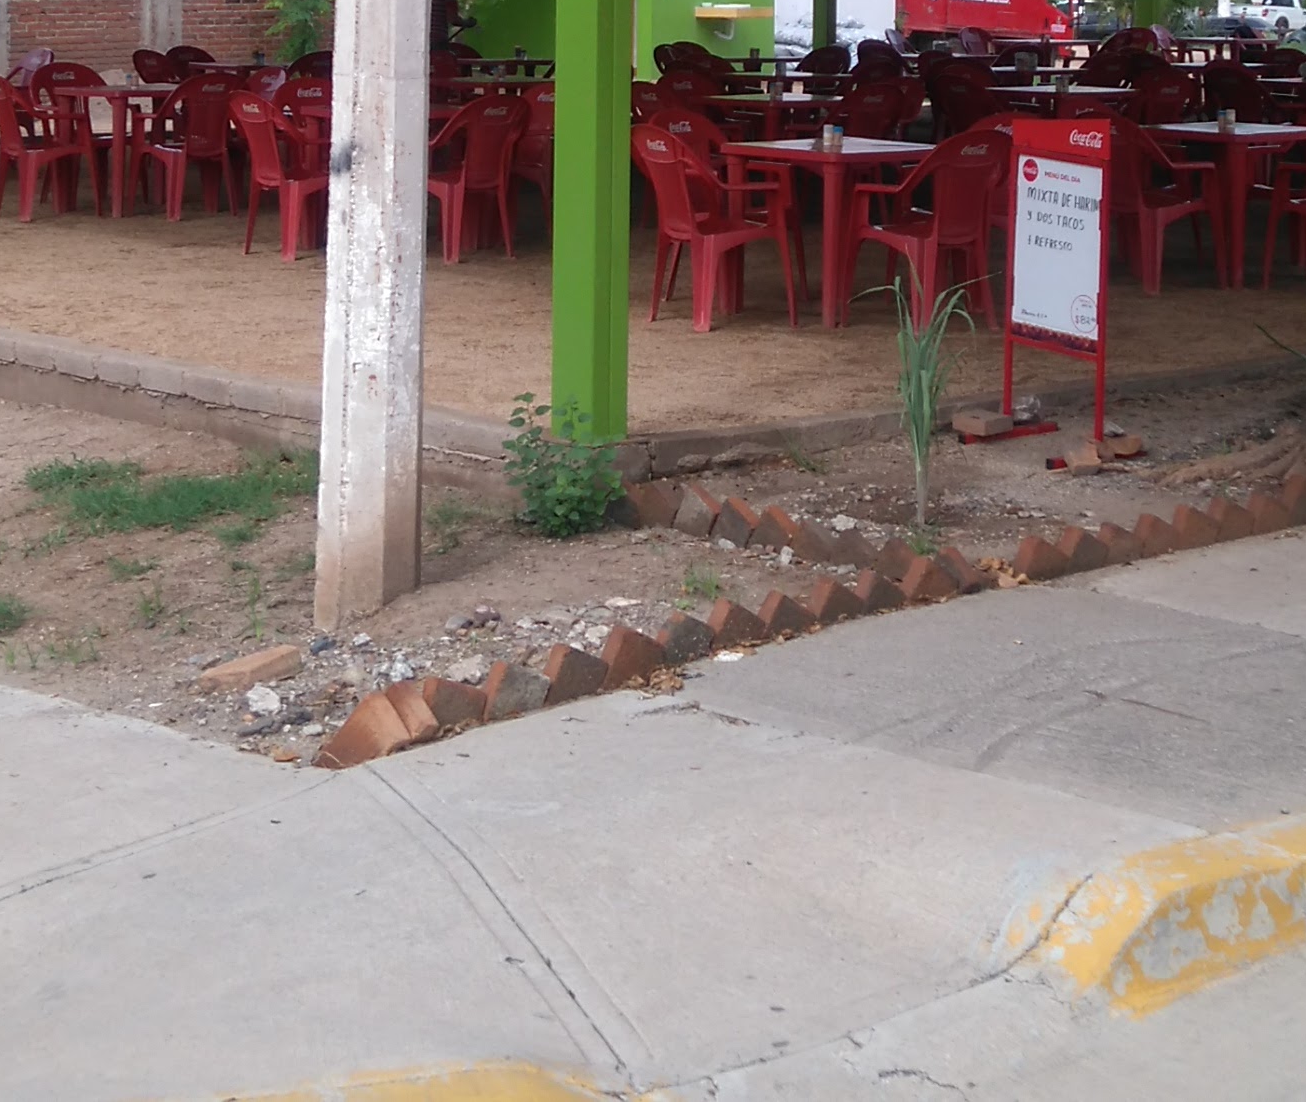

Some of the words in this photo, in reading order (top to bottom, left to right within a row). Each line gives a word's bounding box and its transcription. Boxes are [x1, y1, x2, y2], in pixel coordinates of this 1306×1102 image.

[1027, 186, 1059, 205] MIXTA
[1061, 192, 1073, 208] DE
[1037, 212, 1053, 224] DOS
[1057, 214, 1085, 230] TACOS
[1035, 235, 1073, 251] REFRESCO
